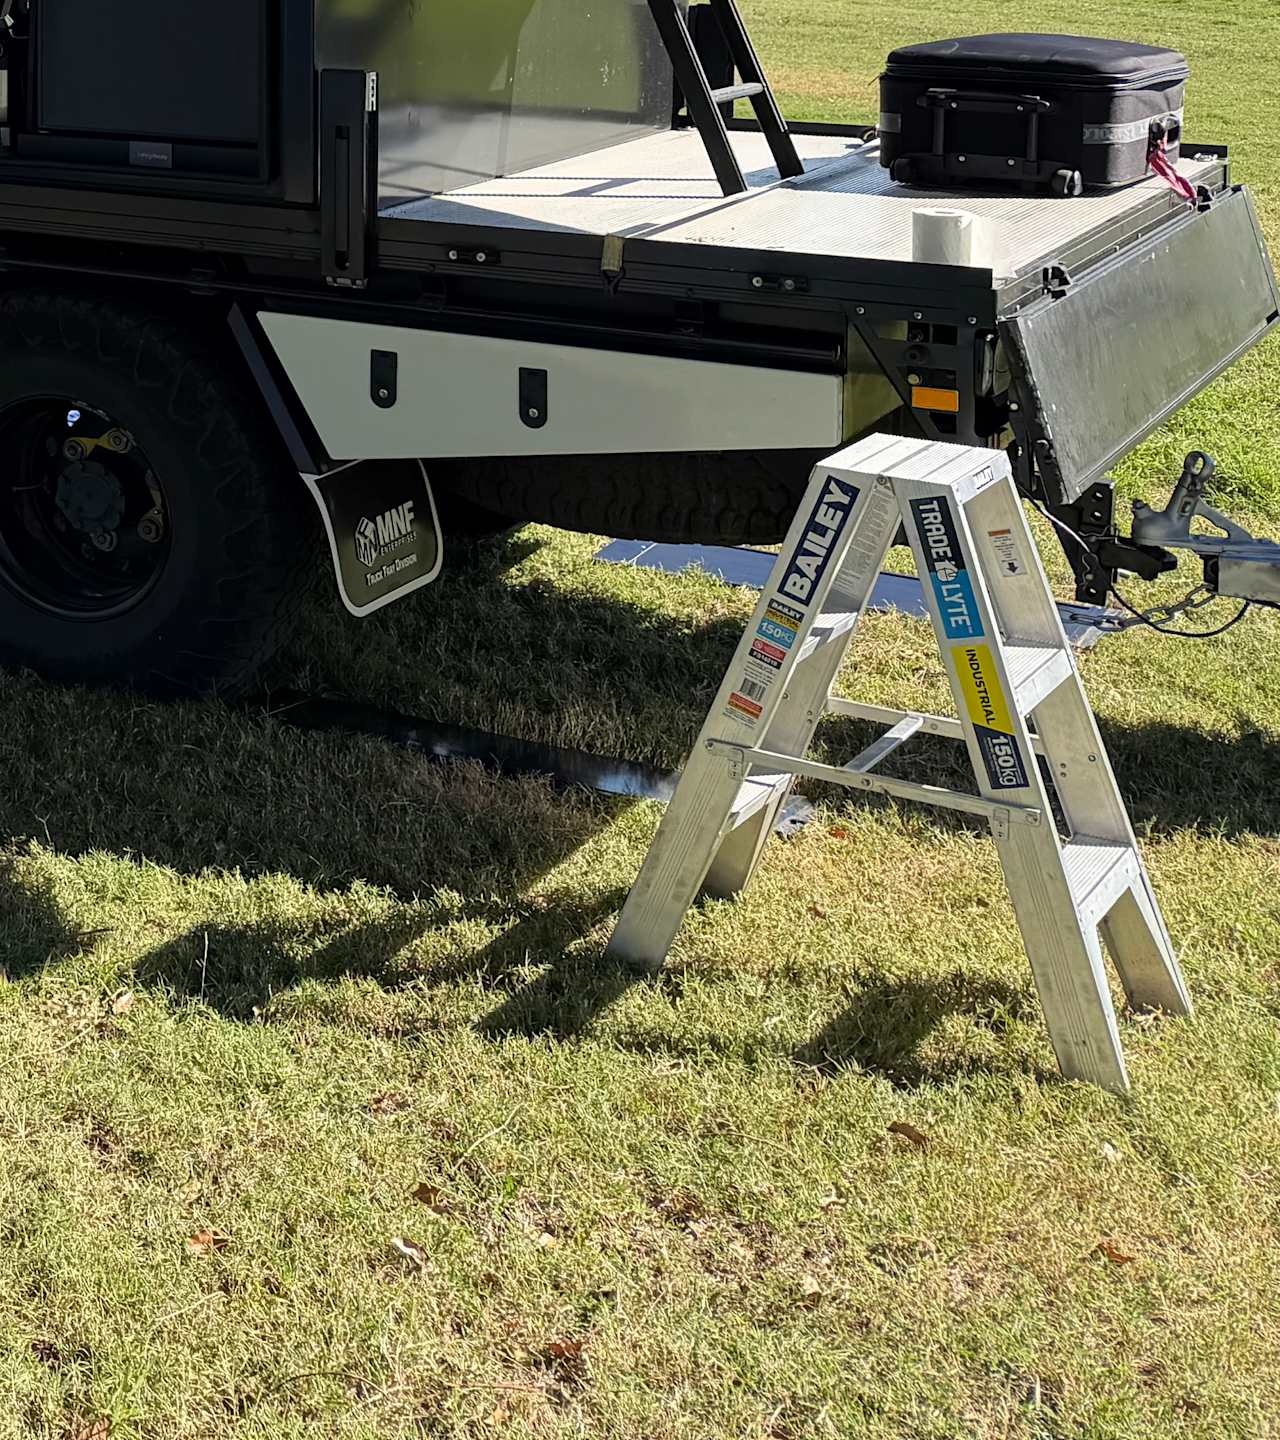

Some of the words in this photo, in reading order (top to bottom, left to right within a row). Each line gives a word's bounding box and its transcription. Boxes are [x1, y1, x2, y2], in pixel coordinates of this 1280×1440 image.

[376, 500, 415, 546] MNF
[380, 531, 417, 556] ENTERPRISES
[784, 480, 852, 598] BAILEY
[917, 501, 950, 560] TRADE
[940, 582, 970, 628] LYTE
[772, 600, 802, 620] BAILEY
[965, 649, 996, 725] INDUSTRIAL
[989, 735, 1017, 785] 150kg
